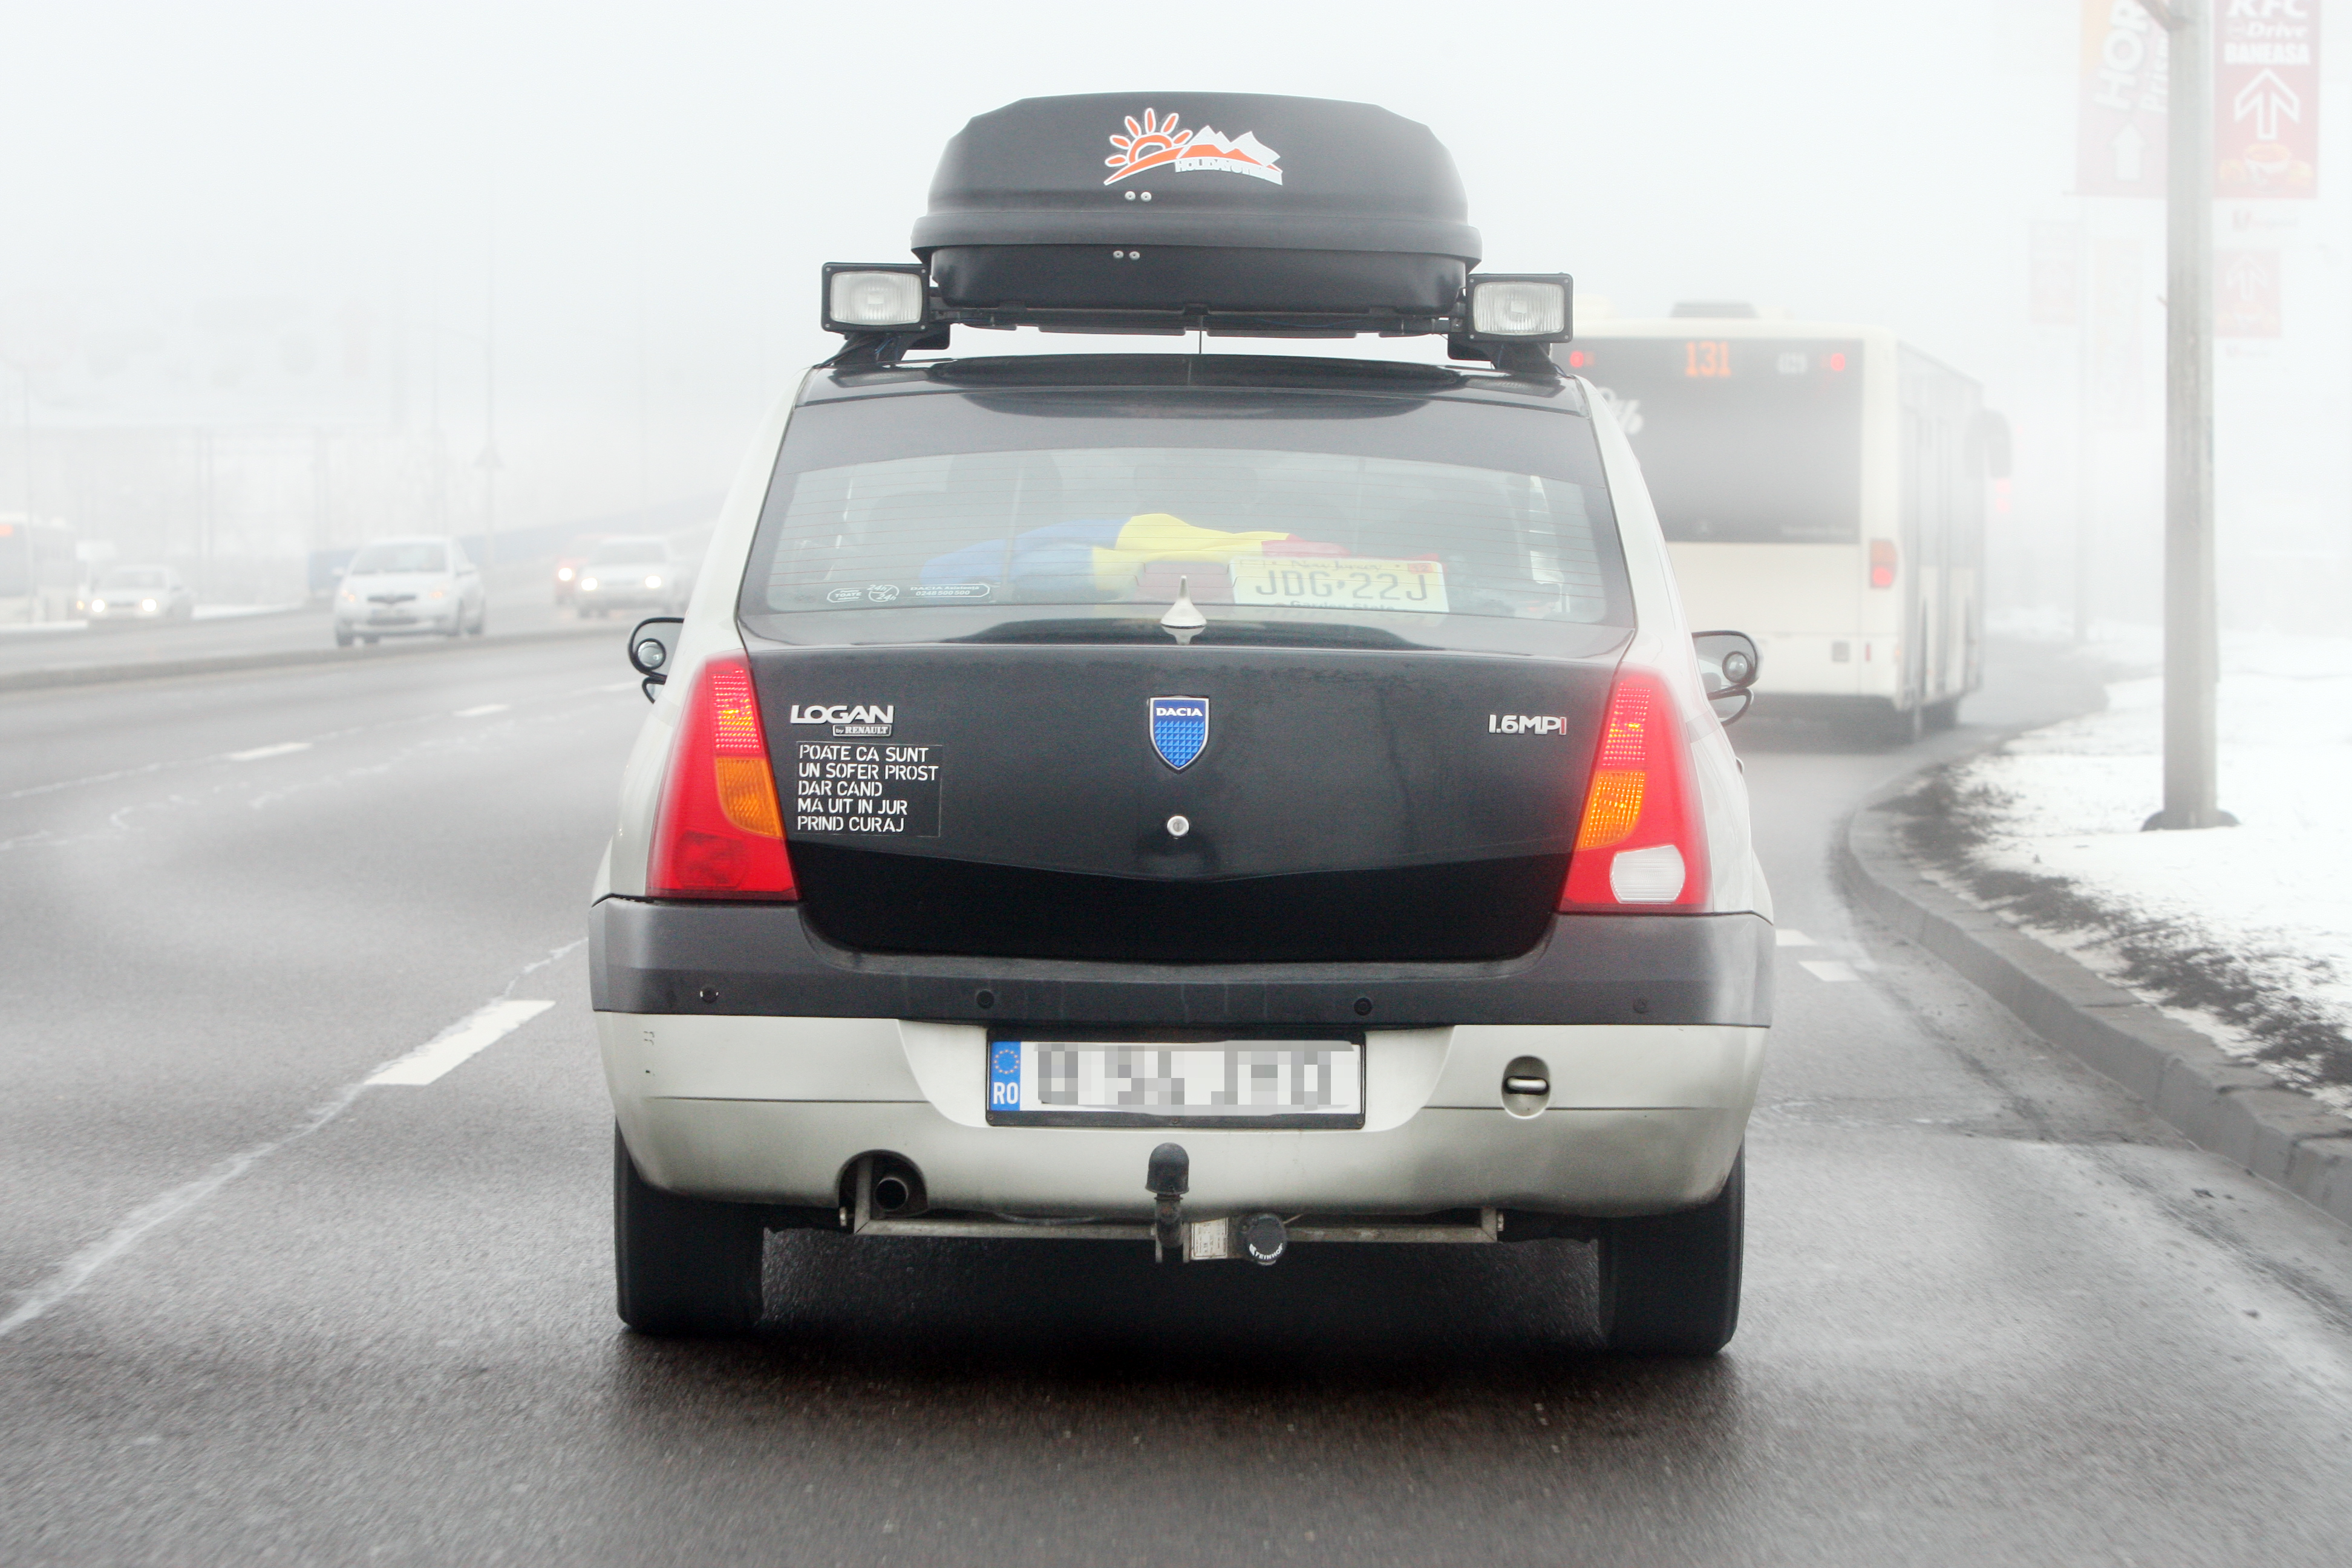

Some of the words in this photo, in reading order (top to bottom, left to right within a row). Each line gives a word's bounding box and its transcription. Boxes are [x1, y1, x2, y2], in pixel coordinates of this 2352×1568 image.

[2247, 21, 2308, 38] Drive
[2224, 42, 2310, 65] BANEASA
[1685, 341, 1731, 377] 131
[790, 705, 894, 724] LOGAN
[1156, 707, 1203, 716] DACIA
[844, 726, 888, 734] RENAULT
[800, 745, 851, 760] POATE
[856, 746, 880, 762] CA
[886, 746, 929, 762] SUNT
[799, 763, 819, 778] UN
[826, 763, 879, 780] SOFER
[885, 765, 939, 781] PROST
[798, 780, 832, 796] DAR
[837, 781, 882, 797] CAND
[797, 799, 823, 813] MA
[828, 799, 854, 814] UIT
[858, 799, 872, 814] IN
[878, 800, 907, 815] JUR
[797, 816, 844, 831] PRIND
[849, 817, 904, 832] CURAJ
[993, 1082, 1018, 1105] RO
